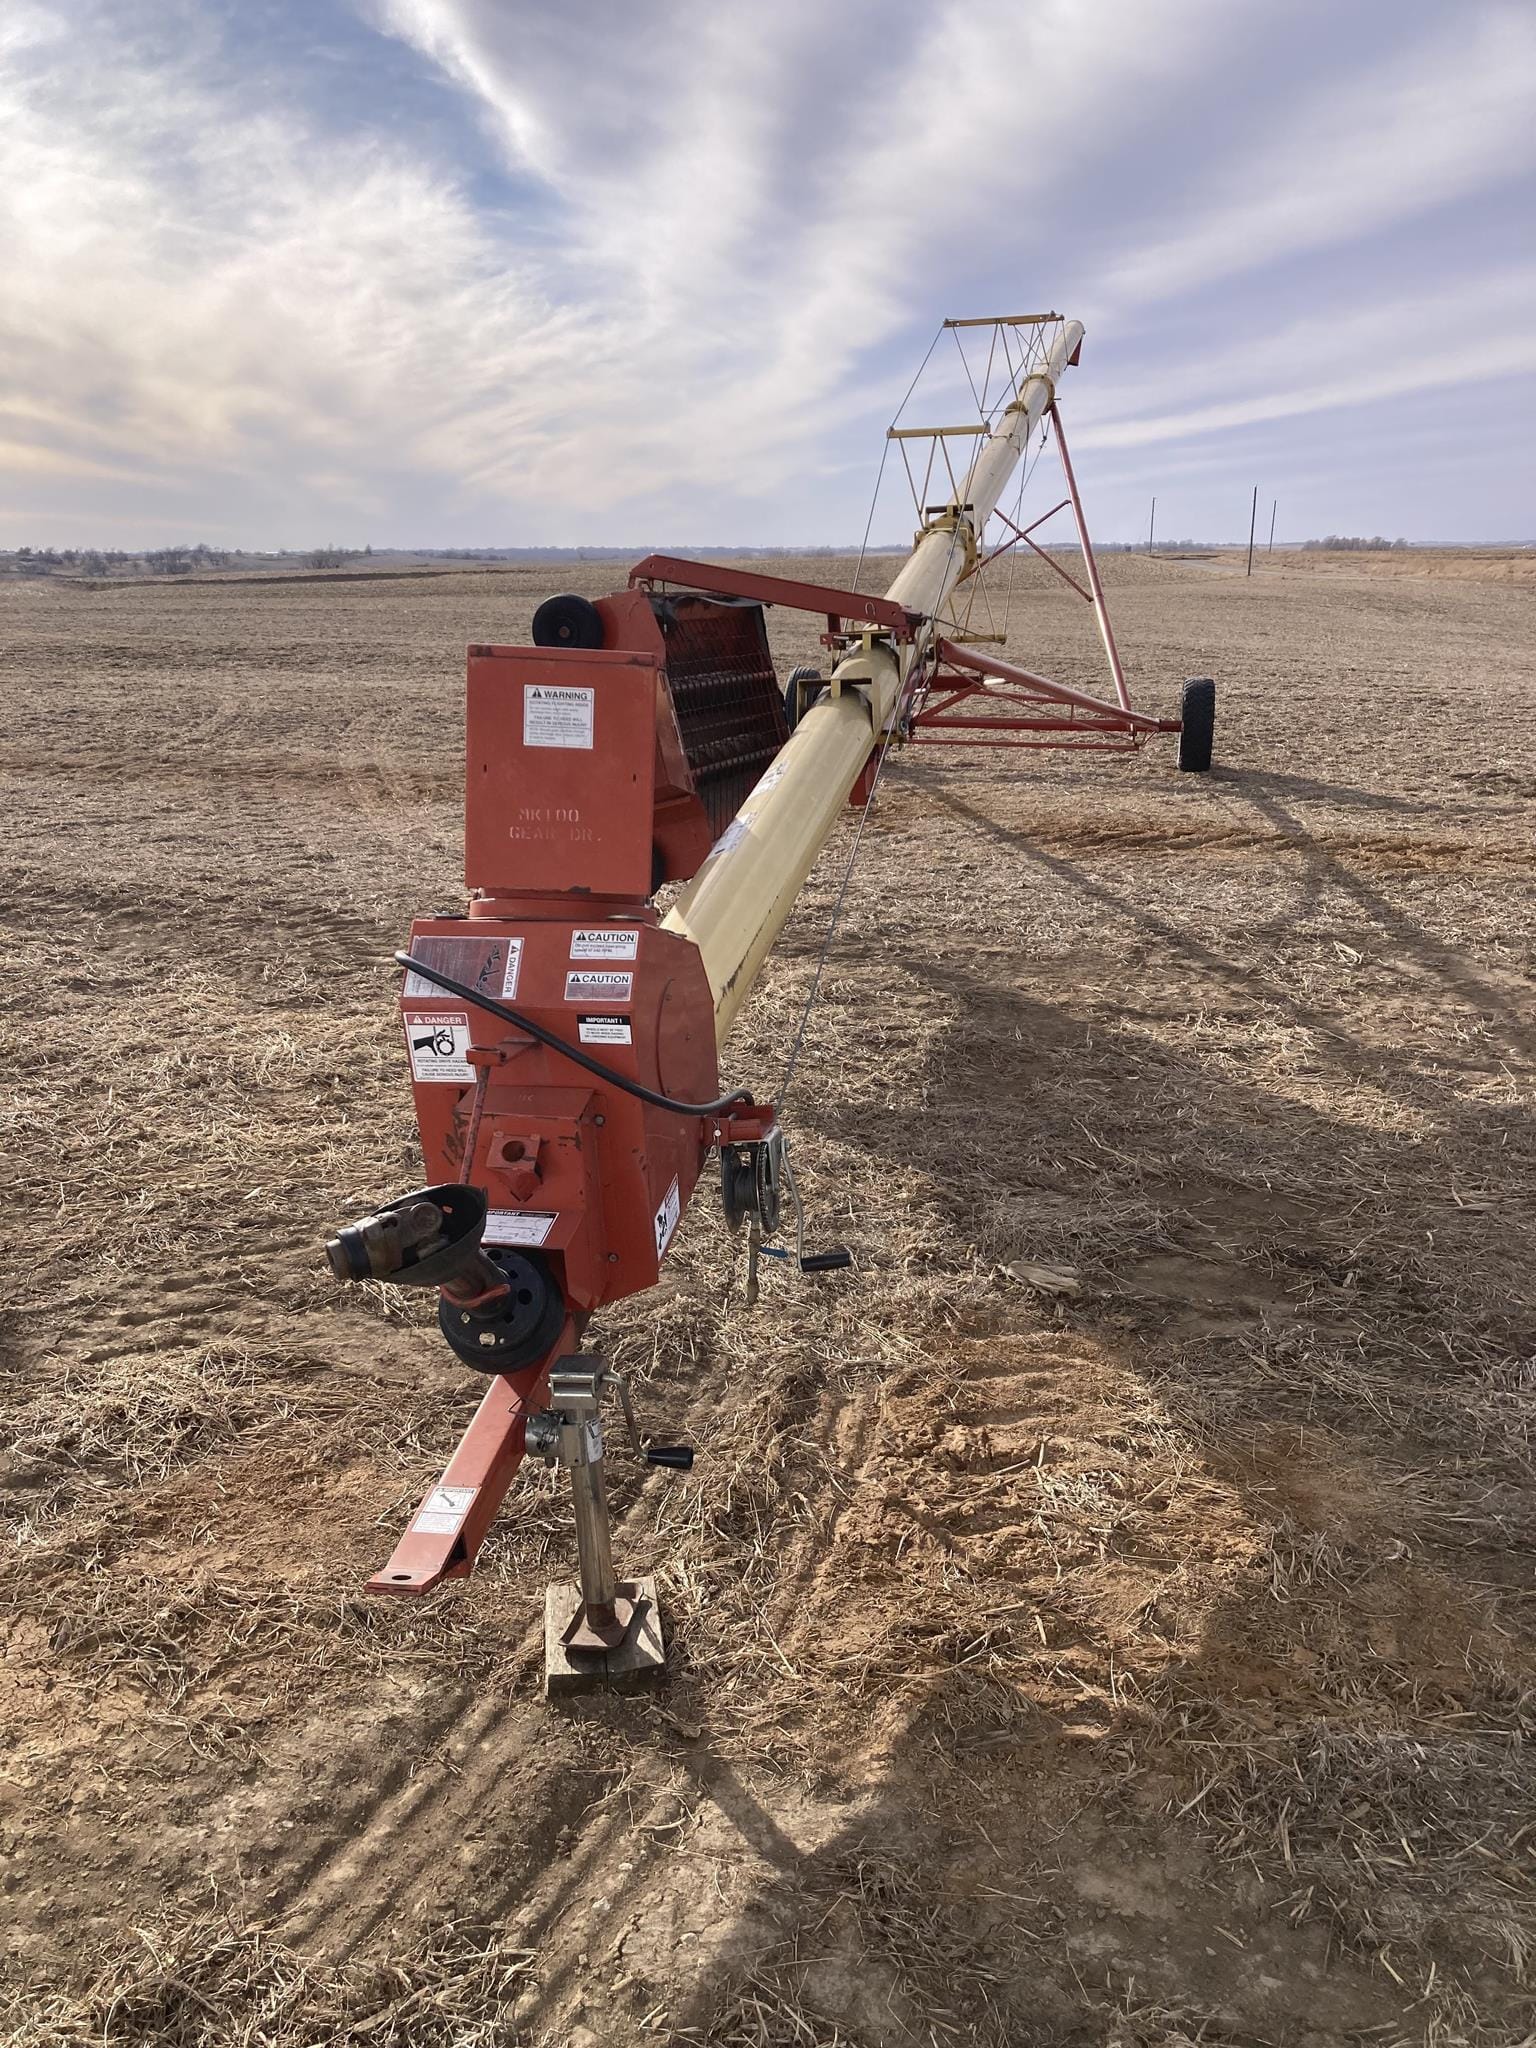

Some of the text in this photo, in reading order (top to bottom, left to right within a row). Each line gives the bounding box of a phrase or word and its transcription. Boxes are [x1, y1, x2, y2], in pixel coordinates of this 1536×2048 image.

[544, 690, 588, 700] WARNING
[588, 933, 635, 942] CAUTION
[504, 957, 517, 993] DANGER
[582, 974, 629, 983] CAUTION
[424, 1016, 462, 1025] DANGER
